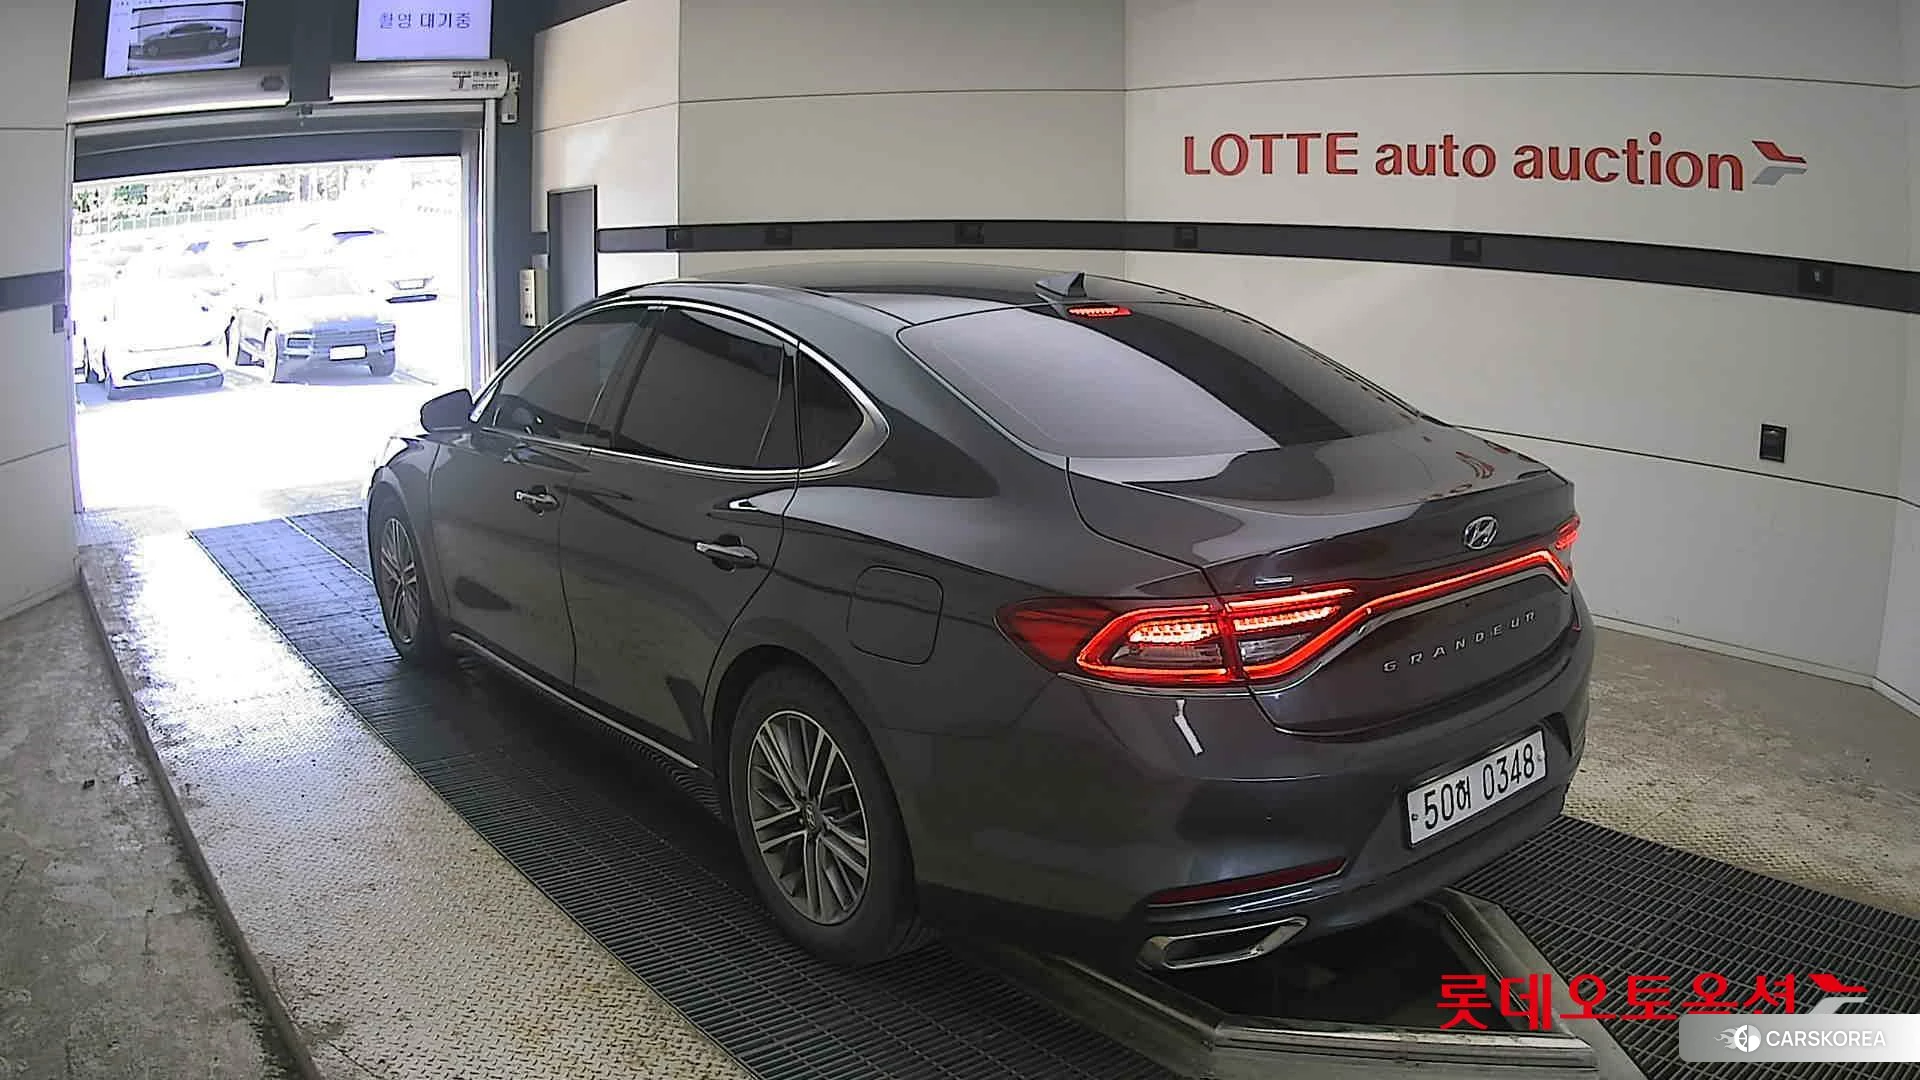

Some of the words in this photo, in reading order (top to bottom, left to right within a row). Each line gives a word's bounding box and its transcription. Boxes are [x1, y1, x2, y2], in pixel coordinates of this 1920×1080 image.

[420, 12, 471, 29] 대기중
[1184, 132, 1358, 176] LOTTE
[1375, 134, 1498, 178] auto
[1512, 131, 1744, 191] auction
[1383, 610, 1536, 672] GRANDEUR
[1423, 775, 1471, 830] 50허
[1482, 743, 1535, 800] 0348
